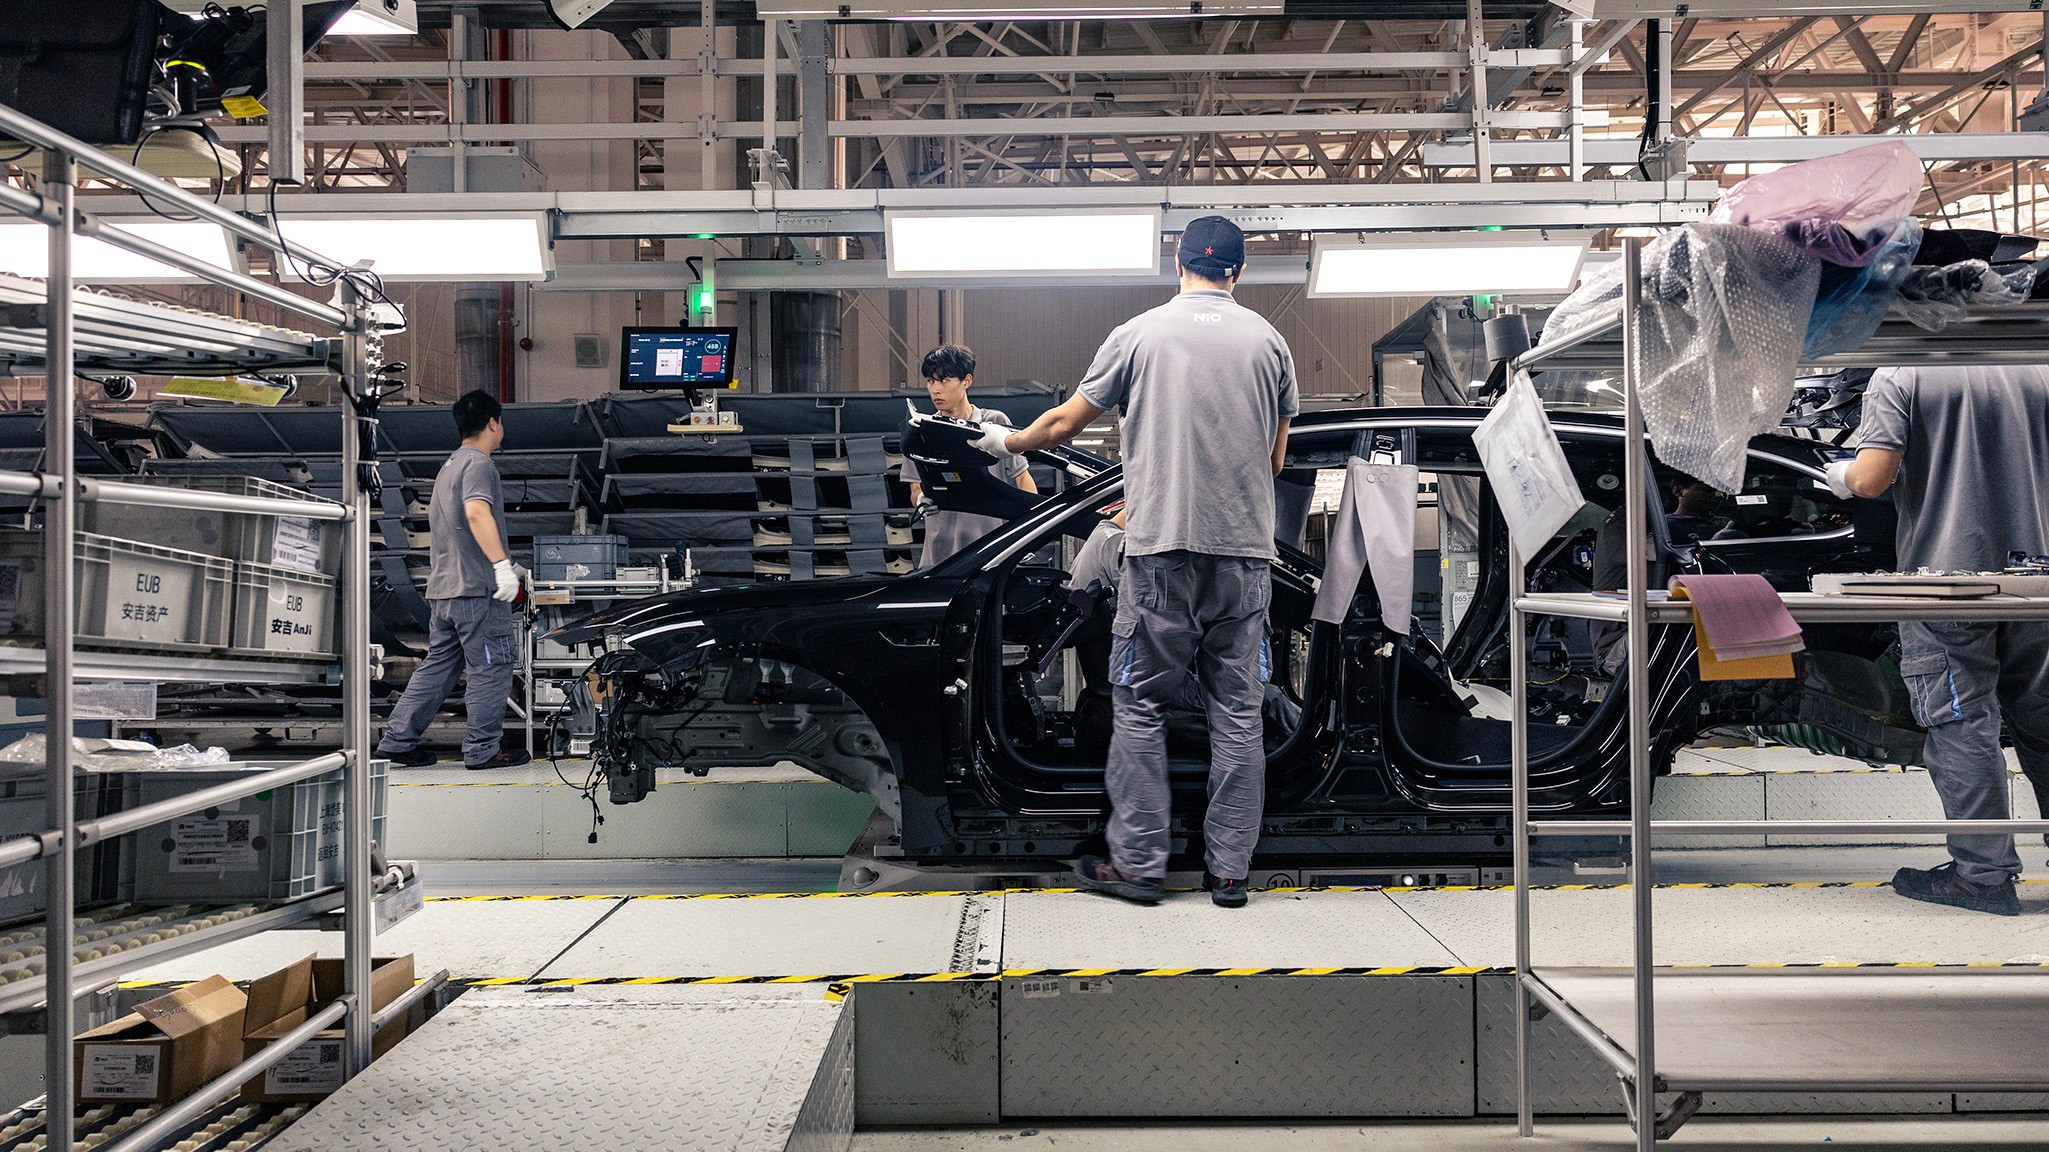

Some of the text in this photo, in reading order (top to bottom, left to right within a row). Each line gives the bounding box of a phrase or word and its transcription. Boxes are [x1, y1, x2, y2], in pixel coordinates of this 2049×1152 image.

[1193, 313, 1222, 323] NIO
[136, 573, 161, 594] EUB
[286, 594, 303, 612] EUB
[121, 602, 169, 623] 安吉资产
[271, 618, 312, 636] 安吉 AnJi
